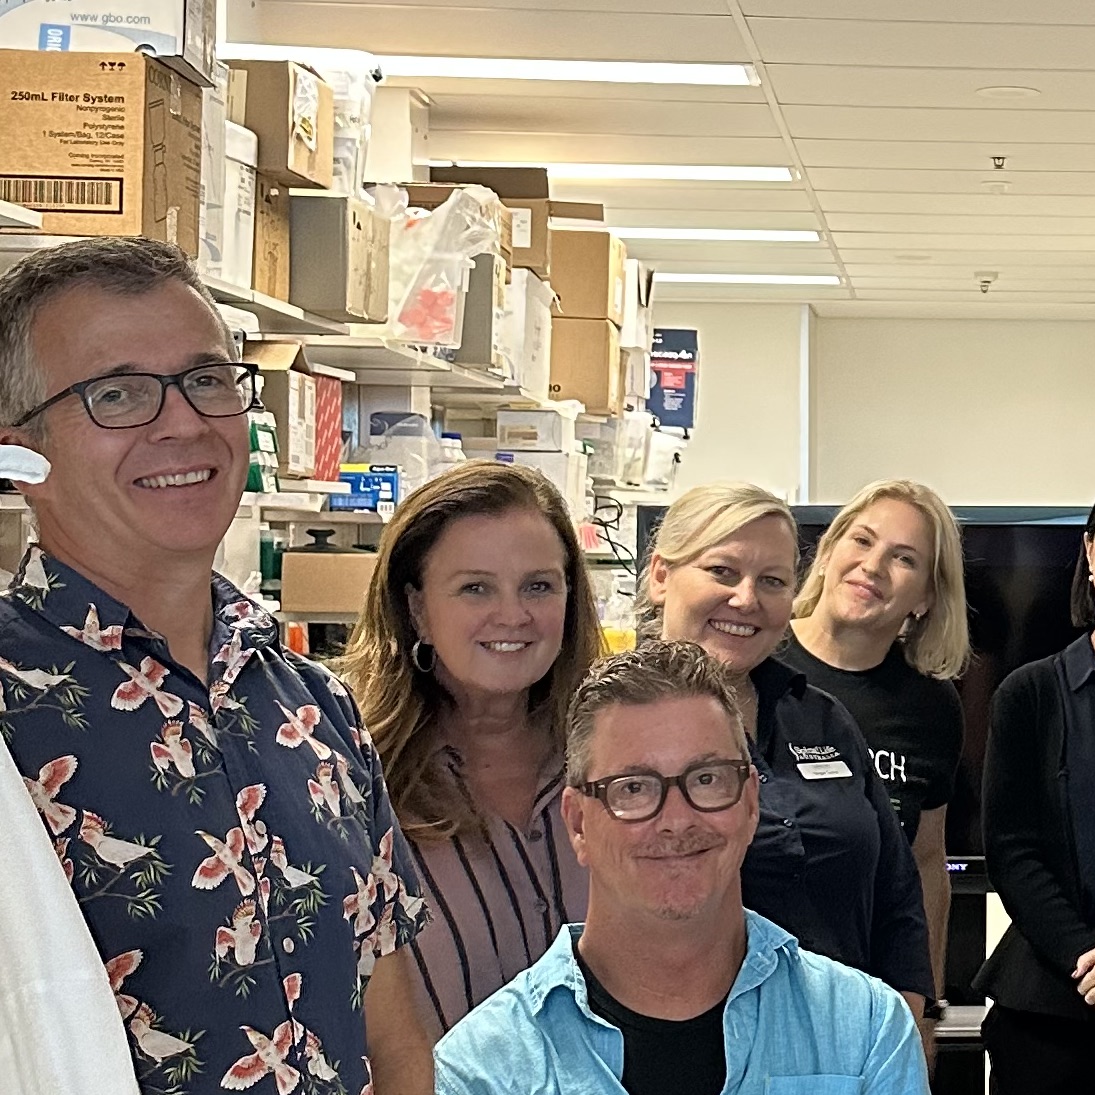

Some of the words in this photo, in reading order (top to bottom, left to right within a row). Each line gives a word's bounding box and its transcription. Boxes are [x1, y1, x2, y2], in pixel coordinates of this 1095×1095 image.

[70, 13, 151, 25] www.gbo.com
[11, 91, 48, 101] 250mL
[51, 92, 80, 102] Filter
[83, 93, 125, 104] System
[868, 748, 907, 782] CH
[946, 863, 968, 871] ONY
